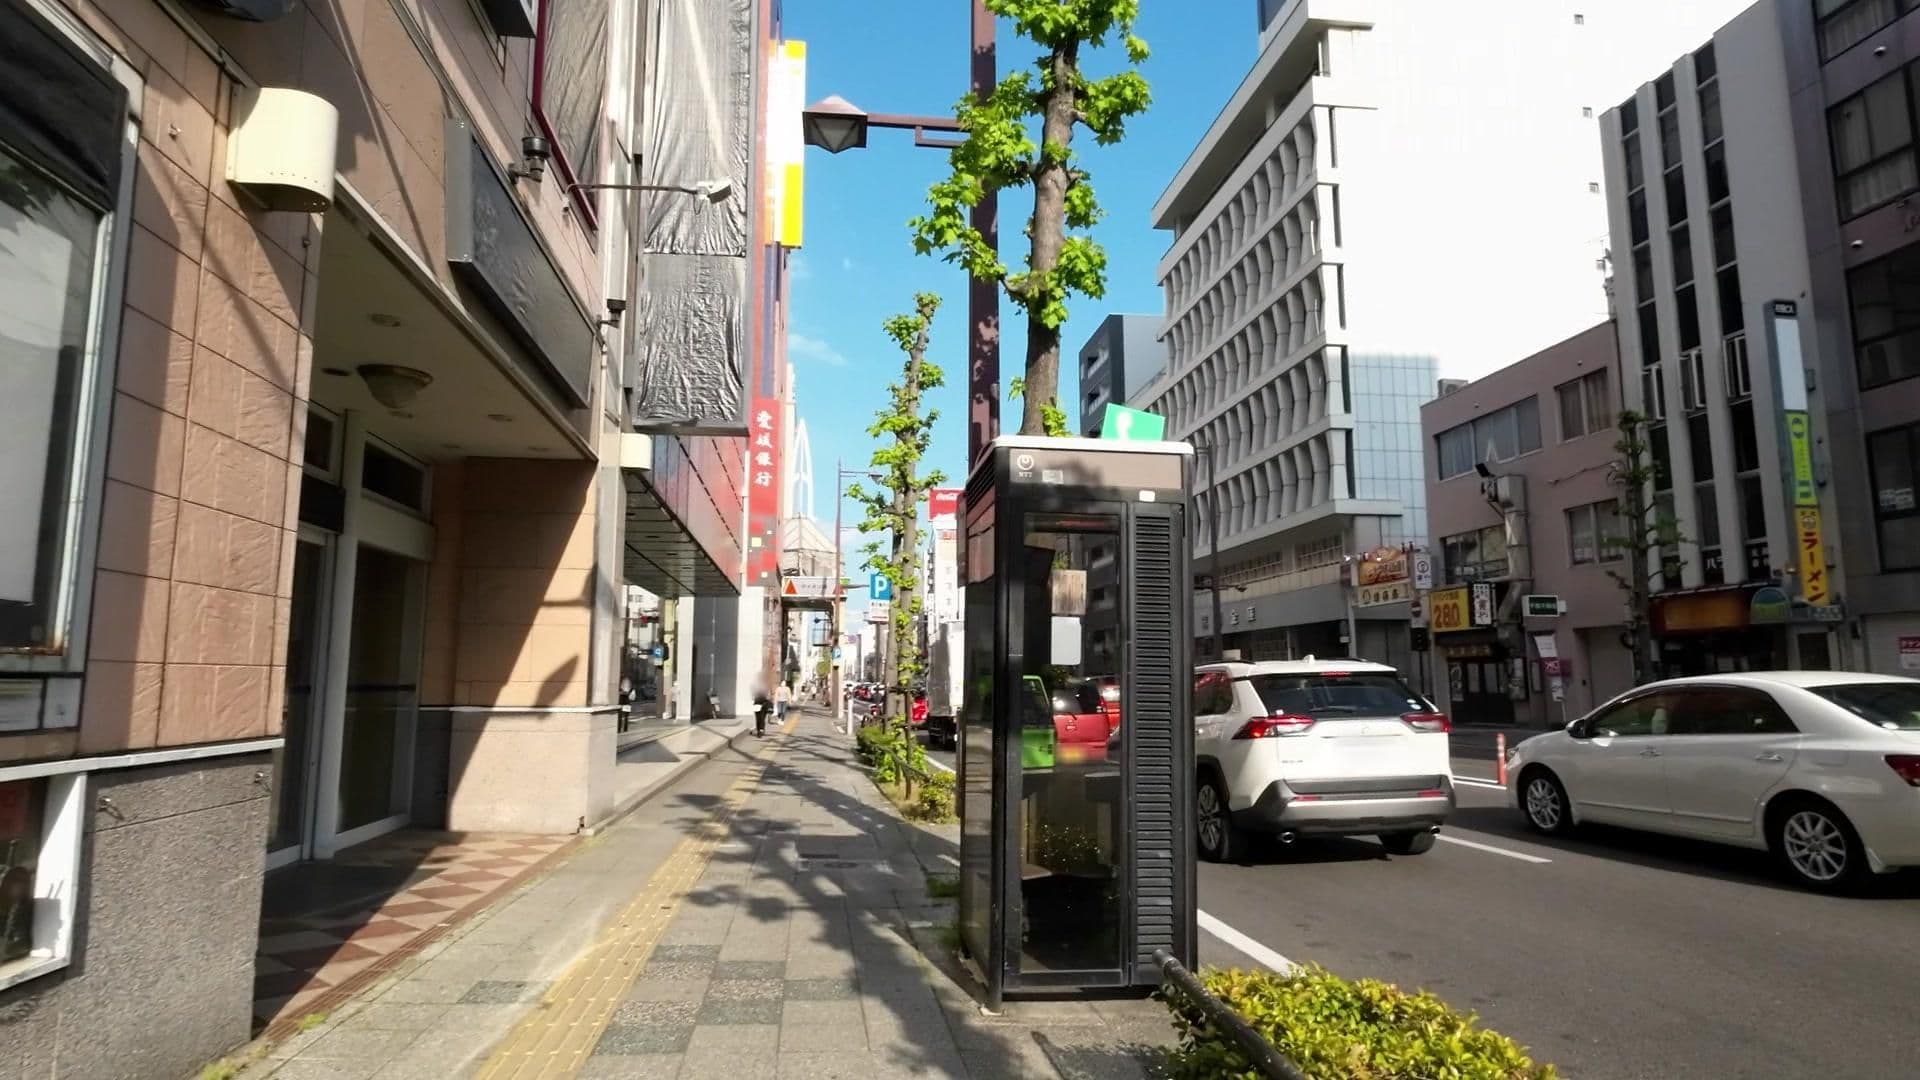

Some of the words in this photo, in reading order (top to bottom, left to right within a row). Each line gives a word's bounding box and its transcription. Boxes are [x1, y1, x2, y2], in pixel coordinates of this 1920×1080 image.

[754, 410, 774, 487] 愛媛銀行
[874, 575, 888, 598] P
[1802, 531, 1825, 602] ラーメン
[1434, 602, 1461, 629] 280
